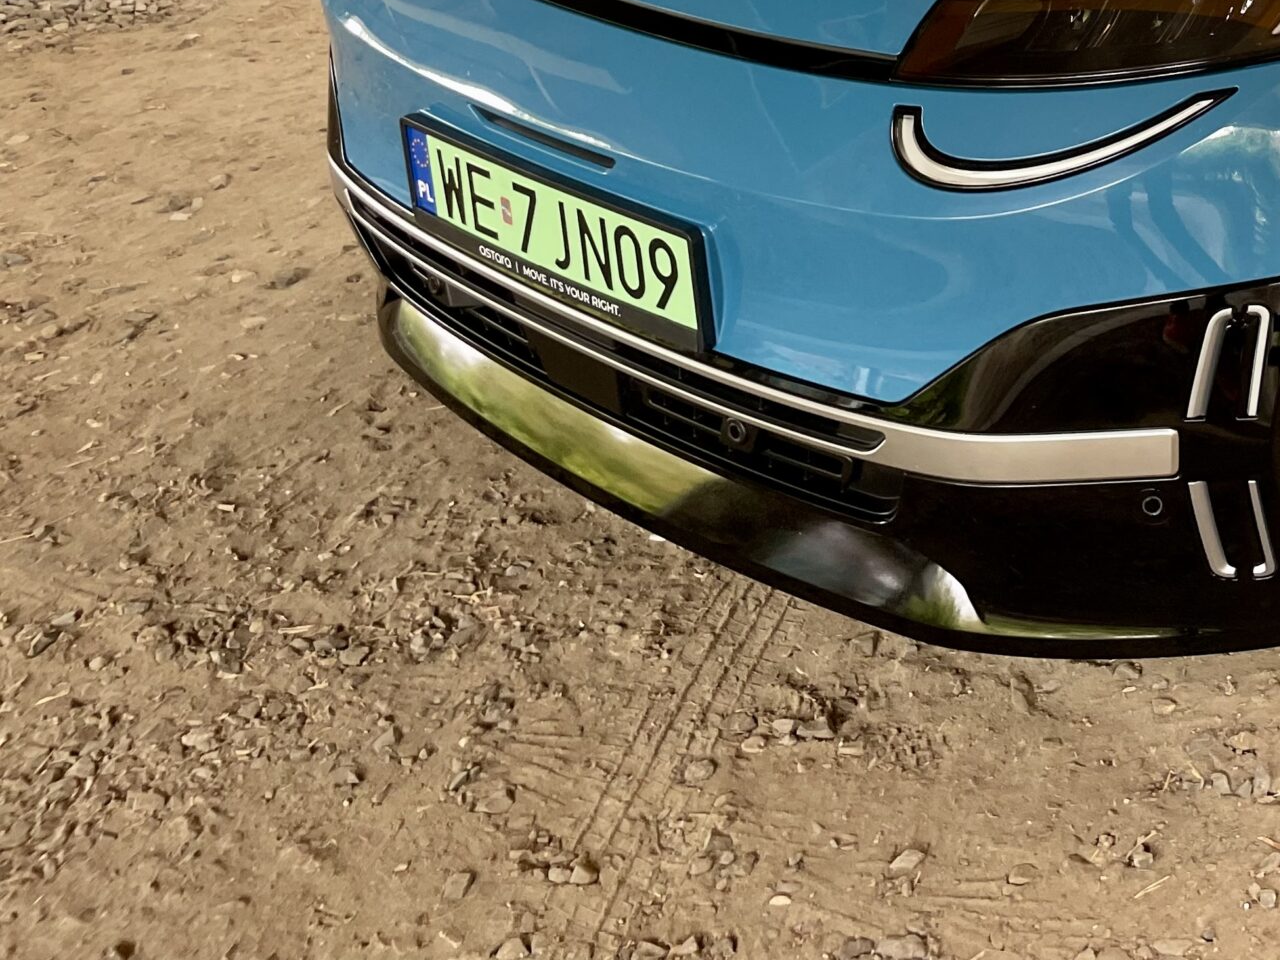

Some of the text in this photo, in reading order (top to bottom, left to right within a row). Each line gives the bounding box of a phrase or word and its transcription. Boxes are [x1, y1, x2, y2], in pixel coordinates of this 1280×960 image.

[417, 179, 435, 203] PL
[436, 148, 500, 241] WE
[564, 283, 591, 304] YOUR
